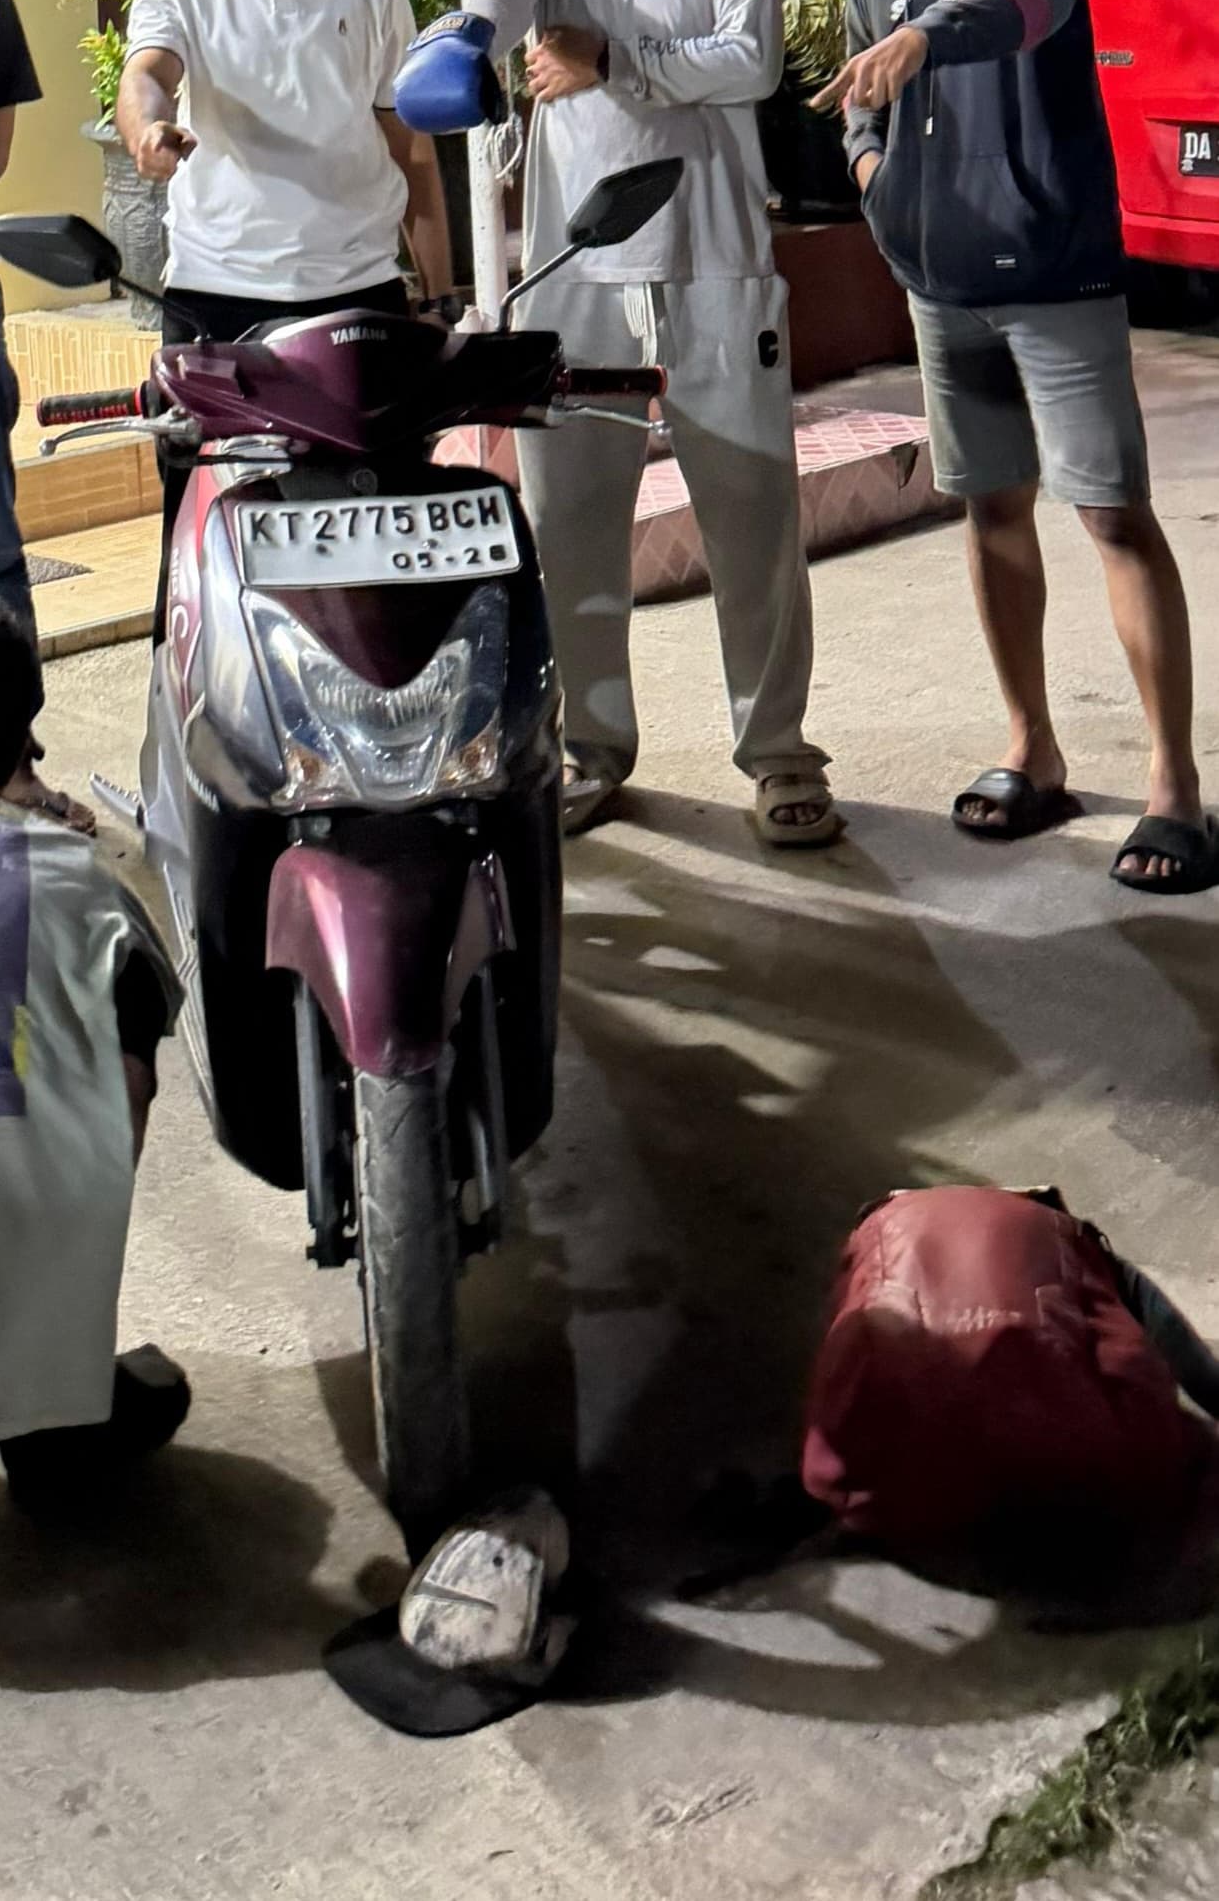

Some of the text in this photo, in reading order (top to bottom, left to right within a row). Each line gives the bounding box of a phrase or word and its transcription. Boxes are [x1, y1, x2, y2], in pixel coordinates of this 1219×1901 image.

[1184, 132, 1211, 160] DA
[330, 326, 388, 345] YAMAHA
[249, 511, 300, 542] KT
[312, 504, 415, 540] 2775
